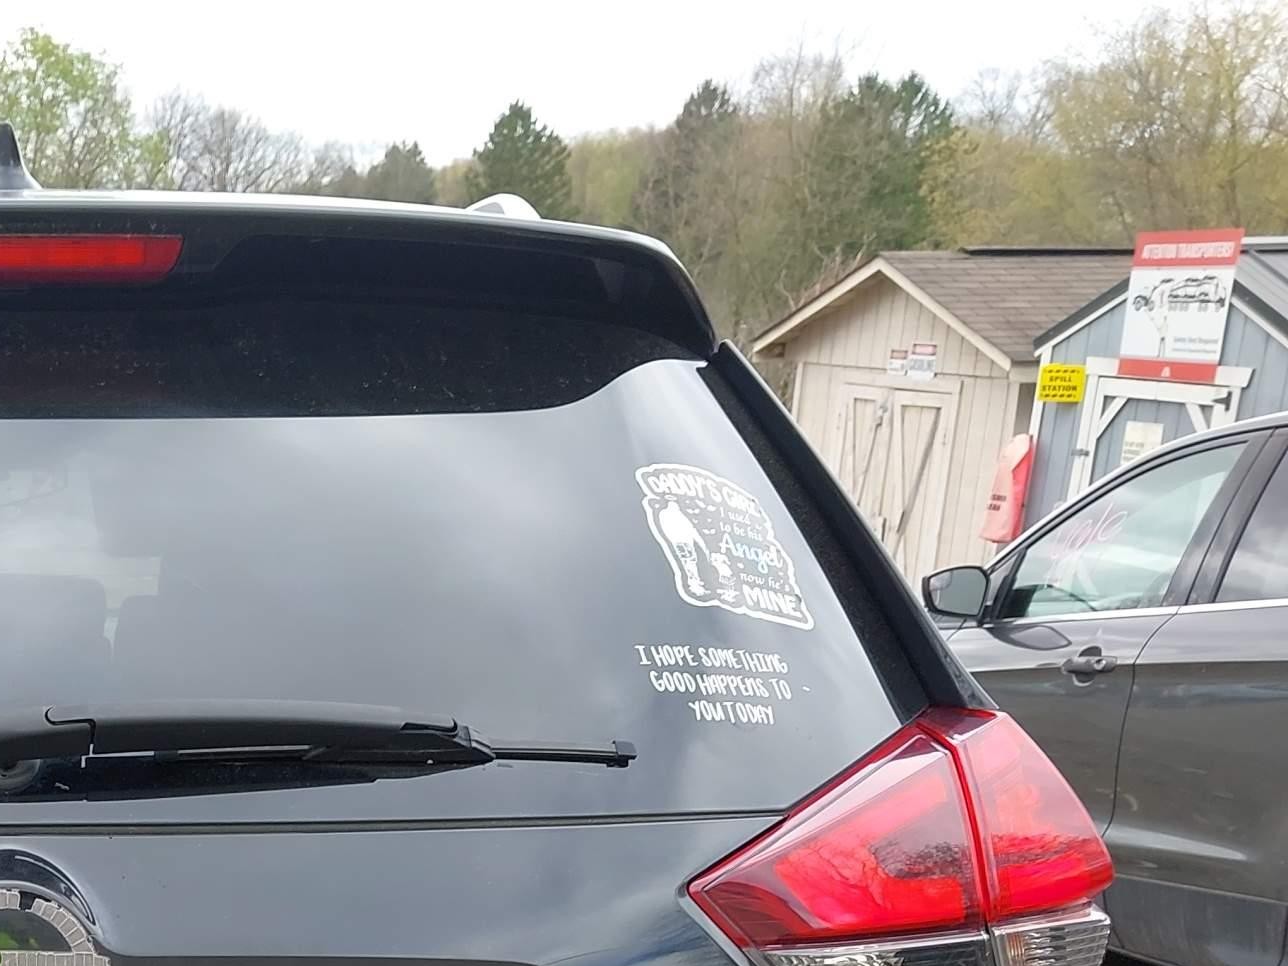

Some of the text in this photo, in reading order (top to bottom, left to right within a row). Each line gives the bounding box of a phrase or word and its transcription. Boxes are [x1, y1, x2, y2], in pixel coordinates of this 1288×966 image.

[647, 473, 722, 502] DADDY'S
[719, 533, 783, 573] Angel
[742, 584, 803, 618] MINE
[635, 645, 788, 674] I HOPE SOMETHING
[649, 670, 791, 700] GOOD HAPPENS TO
